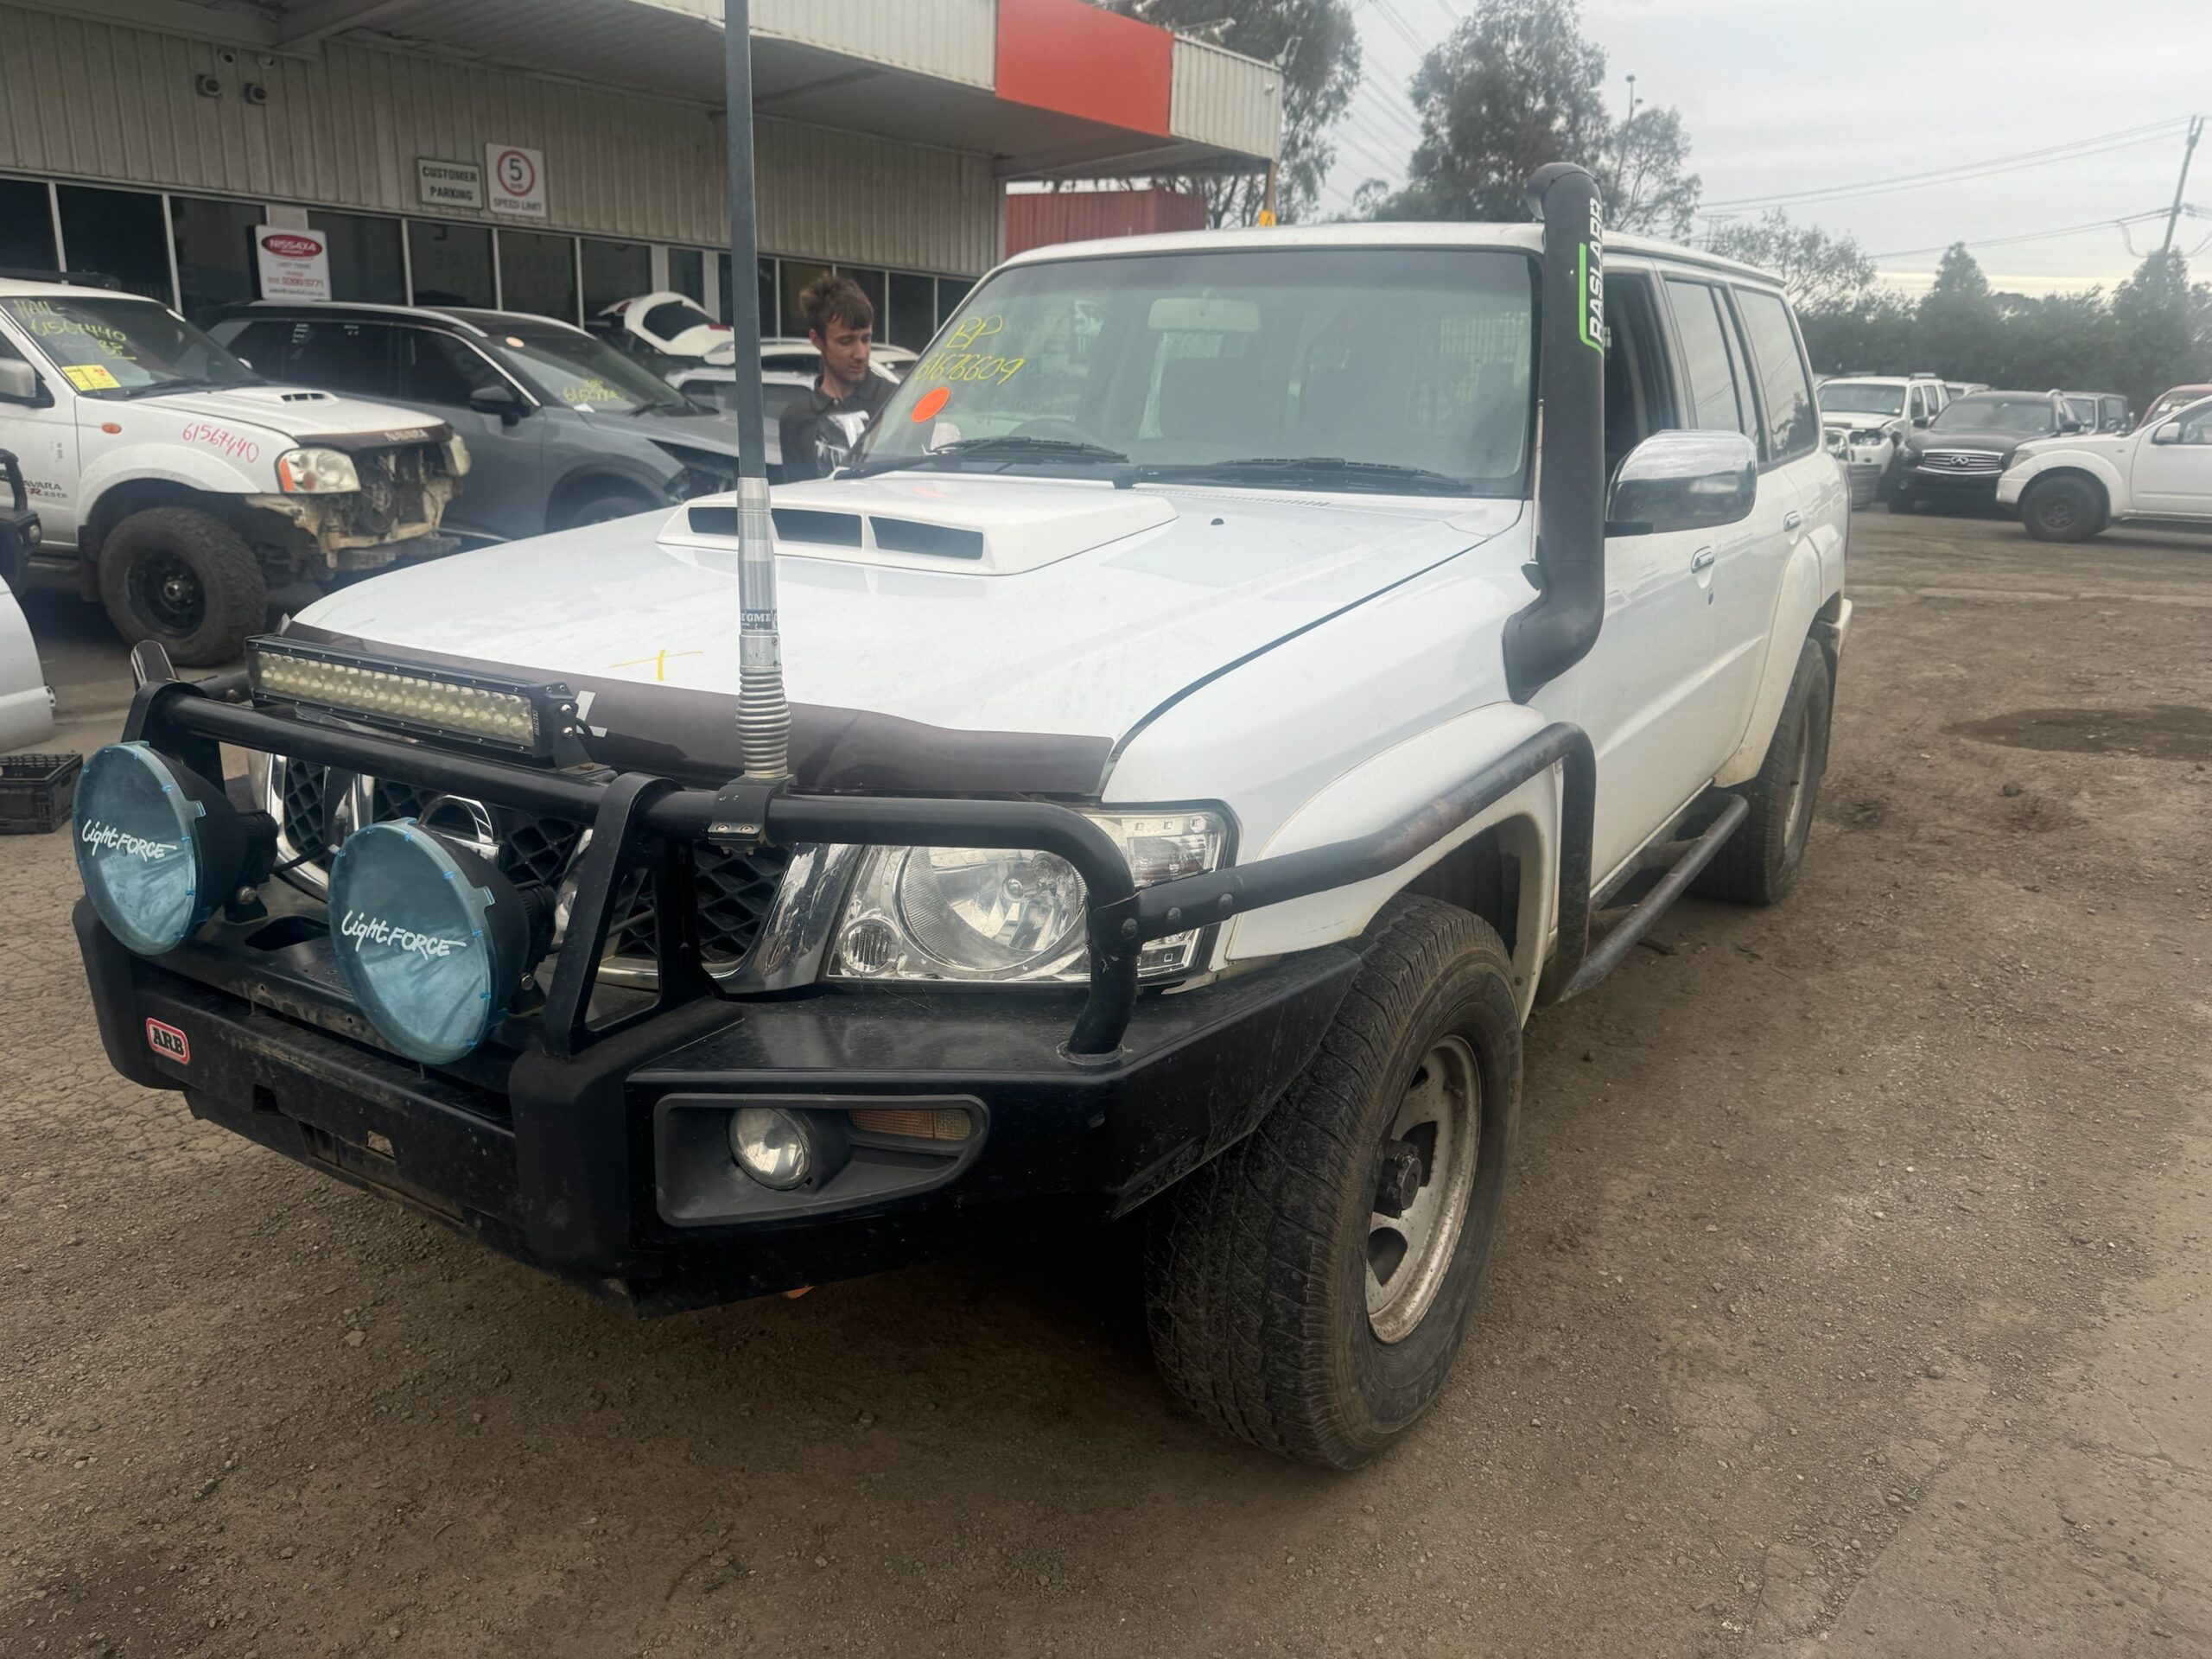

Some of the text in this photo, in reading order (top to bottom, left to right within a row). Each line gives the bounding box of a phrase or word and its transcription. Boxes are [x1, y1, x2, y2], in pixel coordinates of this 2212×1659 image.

[422, 166, 478, 183] CUSTOMER
[508, 157, 523, 181] 5
[429, 187, 474, 201] PARKING
[493, 198, 543, 212] SPEED LIMIT
[181, 422, 260, 464] 61567440
[23, 479, 62, 492] AVARA
[746, 613, 772, 622] GME
[151, 1026, 186, 1057] ARB
